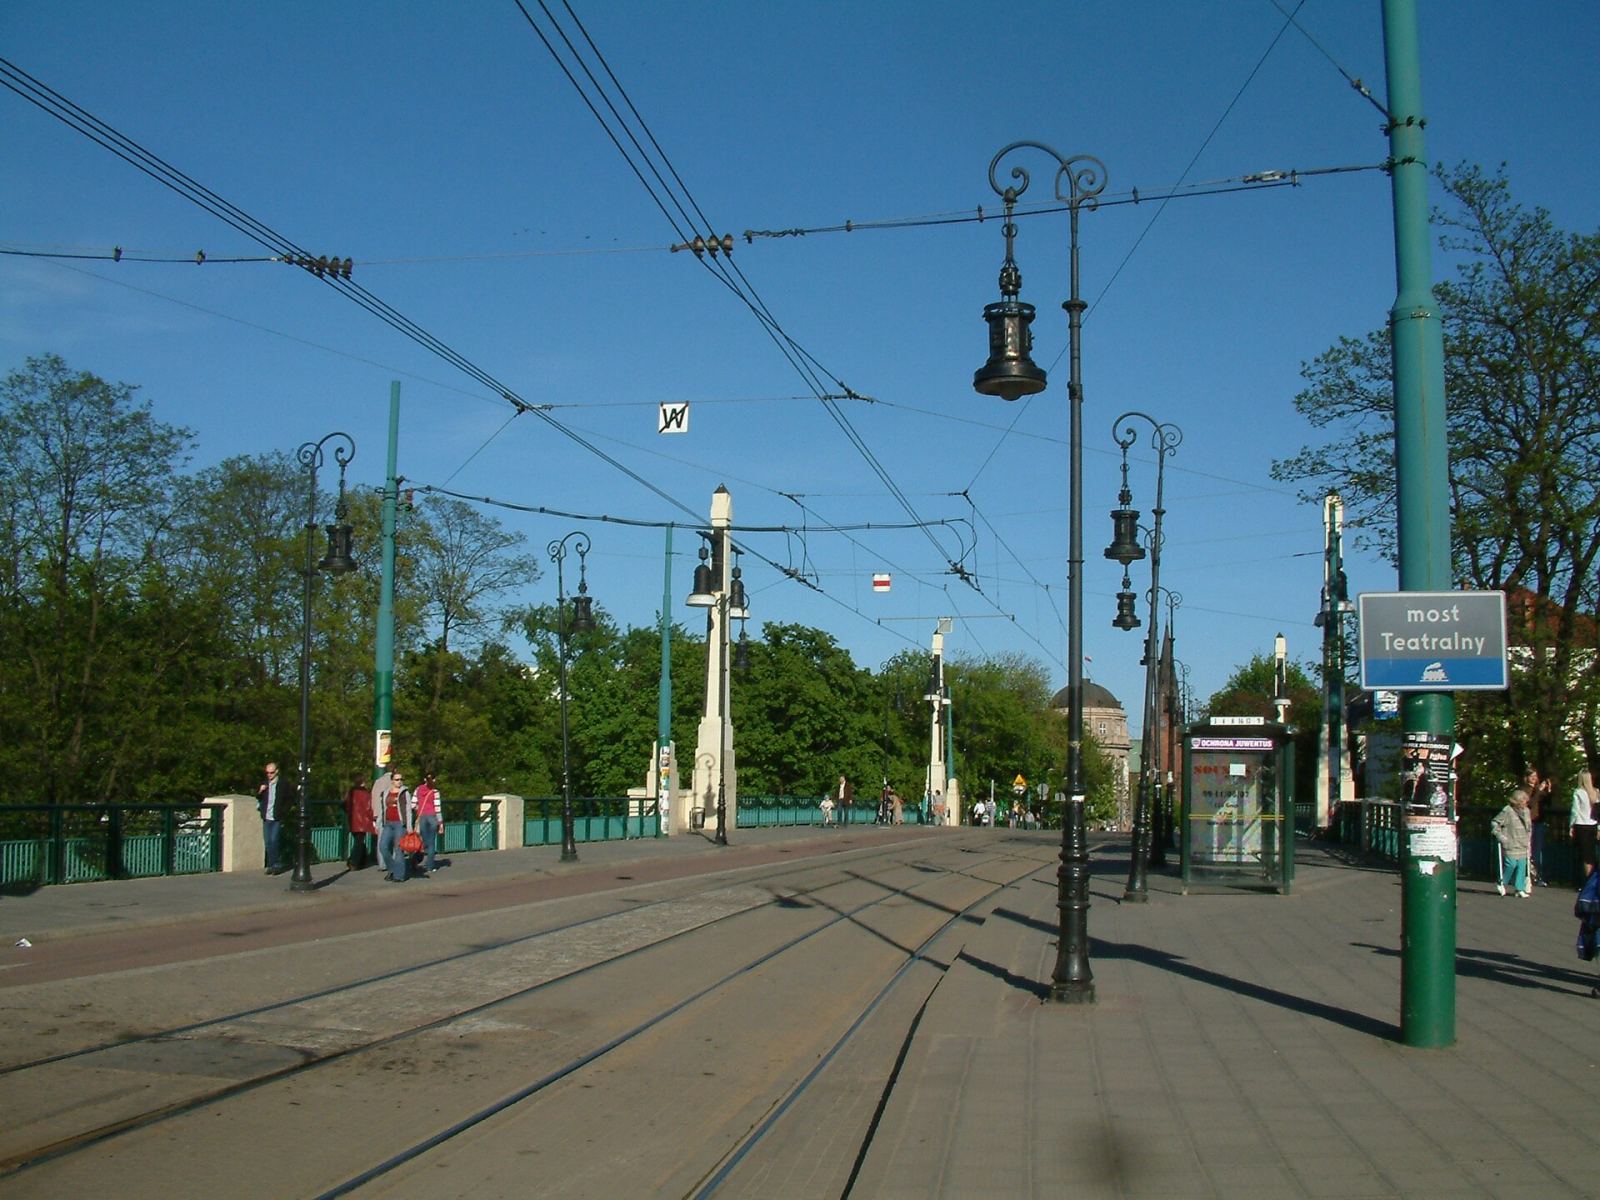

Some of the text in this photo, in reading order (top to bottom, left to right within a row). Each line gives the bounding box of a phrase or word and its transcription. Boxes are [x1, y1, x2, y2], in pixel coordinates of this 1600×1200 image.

[662, 408, 686, 429] W
[1407, 604, 1460, 622] most
[1381, 632, 1486, 656] Teatralny
